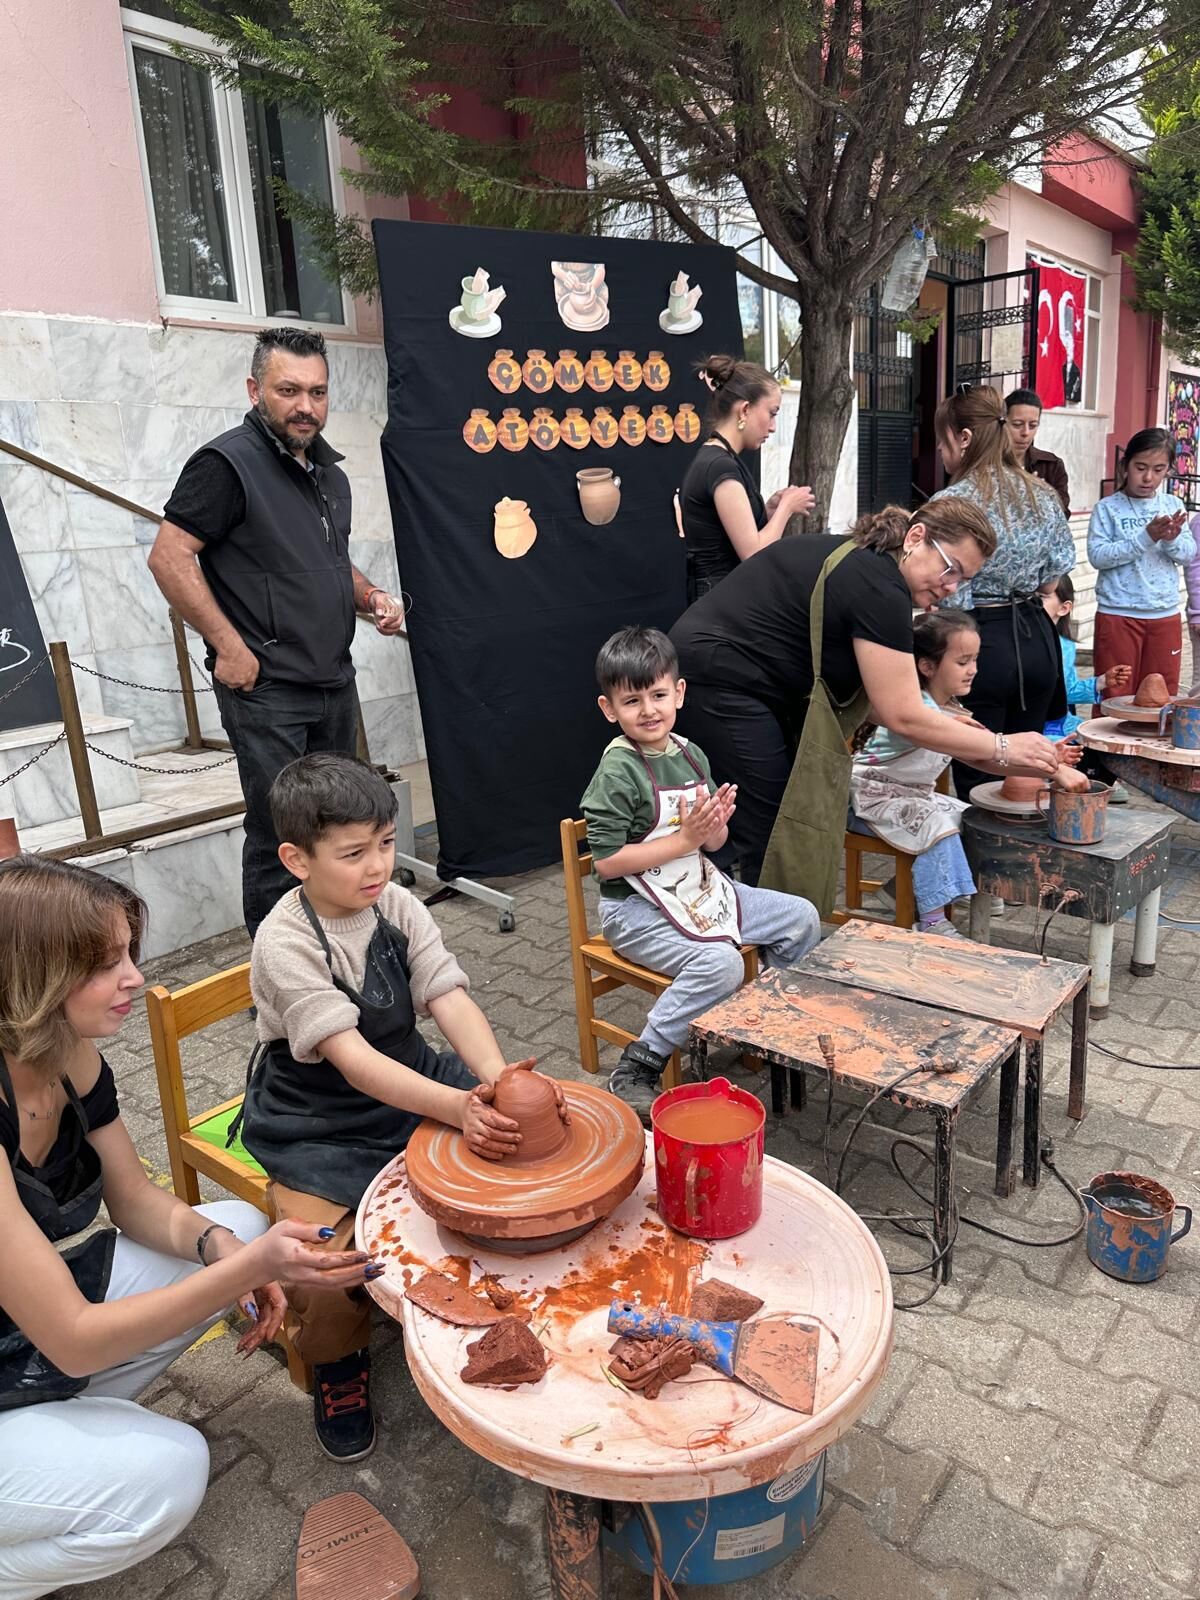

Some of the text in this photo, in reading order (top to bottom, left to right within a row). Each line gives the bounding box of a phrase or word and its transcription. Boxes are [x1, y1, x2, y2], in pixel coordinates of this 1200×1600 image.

[495, 360, 664, 389] ÇÖMLEK
[472, 413, 691, 447] ATÖLYESİ
[301, 1522, 385, 1559] SHIMPO
